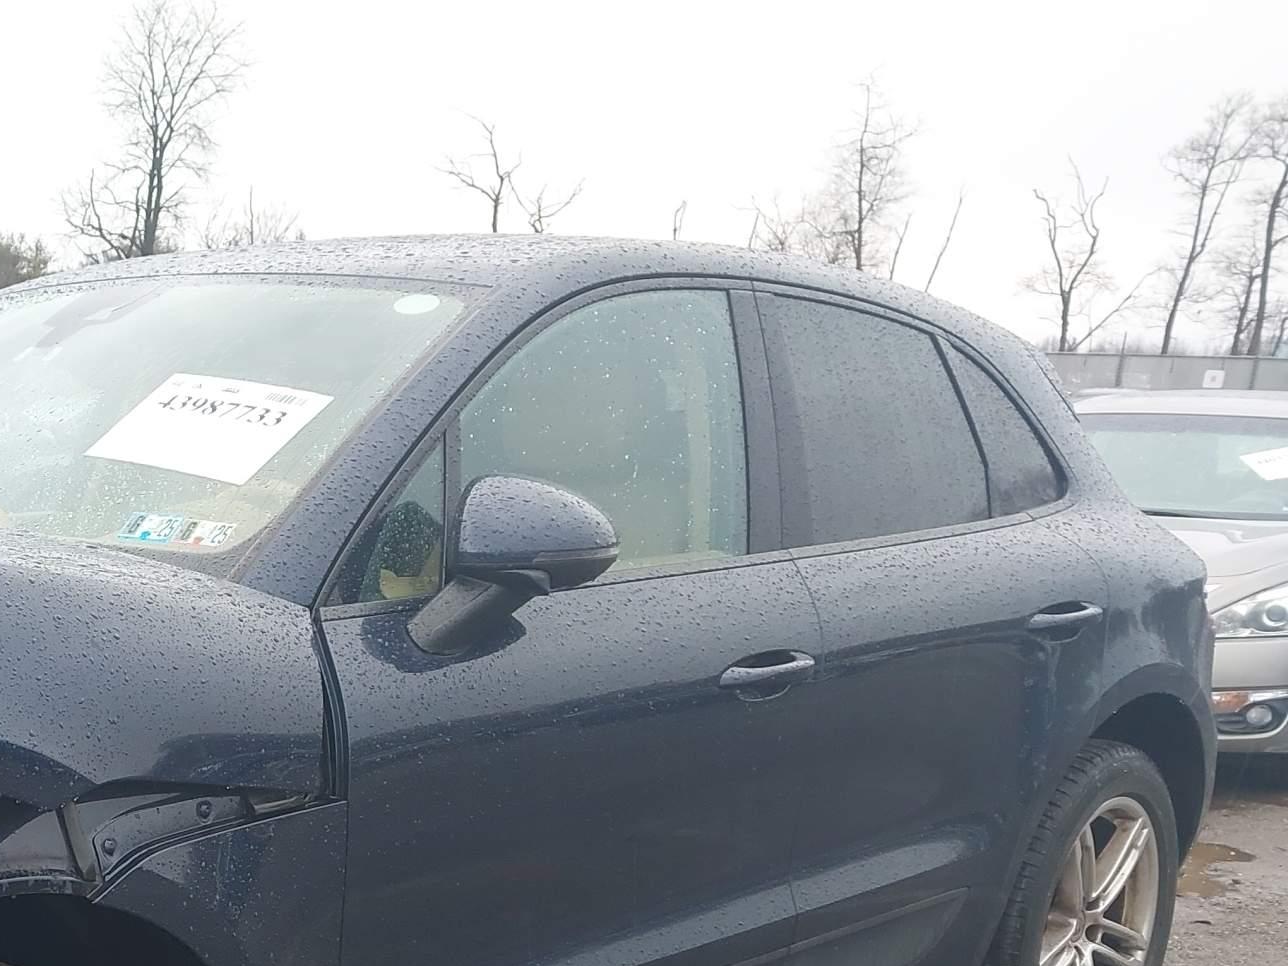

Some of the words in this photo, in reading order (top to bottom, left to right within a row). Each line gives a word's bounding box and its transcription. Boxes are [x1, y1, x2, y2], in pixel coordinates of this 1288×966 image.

[158, 394, 288, 426] 43987733
[157, 519, 179, 537] 25
[210, 525, 232, 544] 25
